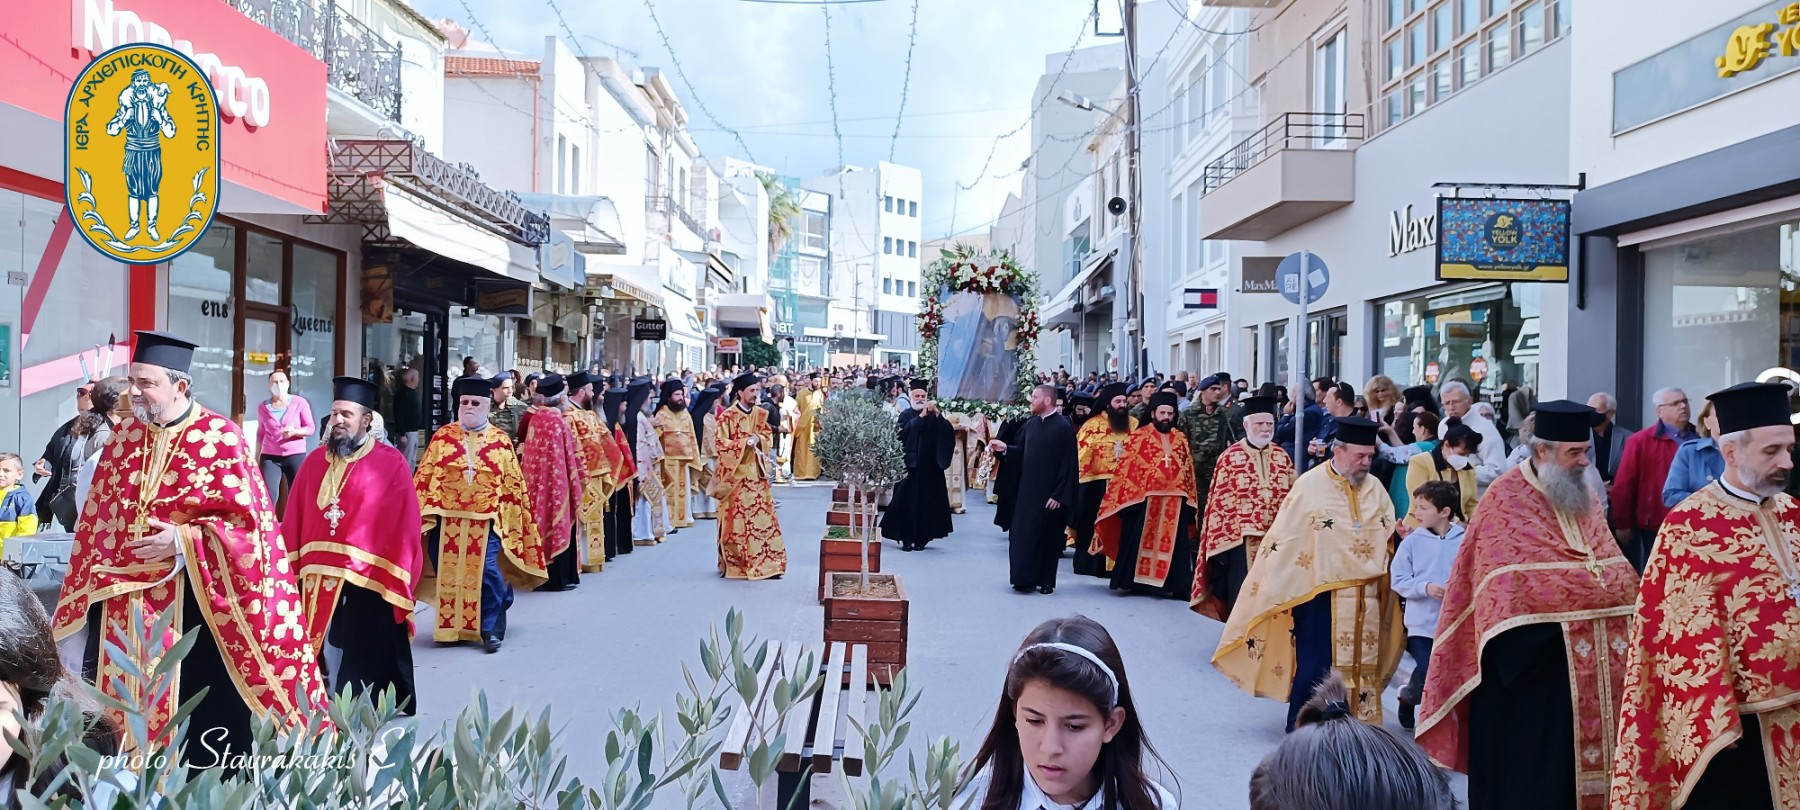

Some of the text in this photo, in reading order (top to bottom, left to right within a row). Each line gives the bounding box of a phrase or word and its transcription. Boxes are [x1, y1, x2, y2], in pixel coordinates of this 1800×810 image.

[1776, 2, 1800, 25] YE
[72, 0, 270, 127] NOCCO
[1387, 203, 1437, 258] Max
[1491, 235, 1518, 244] YOLK
[291, 303, 333, 336] Queens
[636, 321, 665, 331] Glitter
